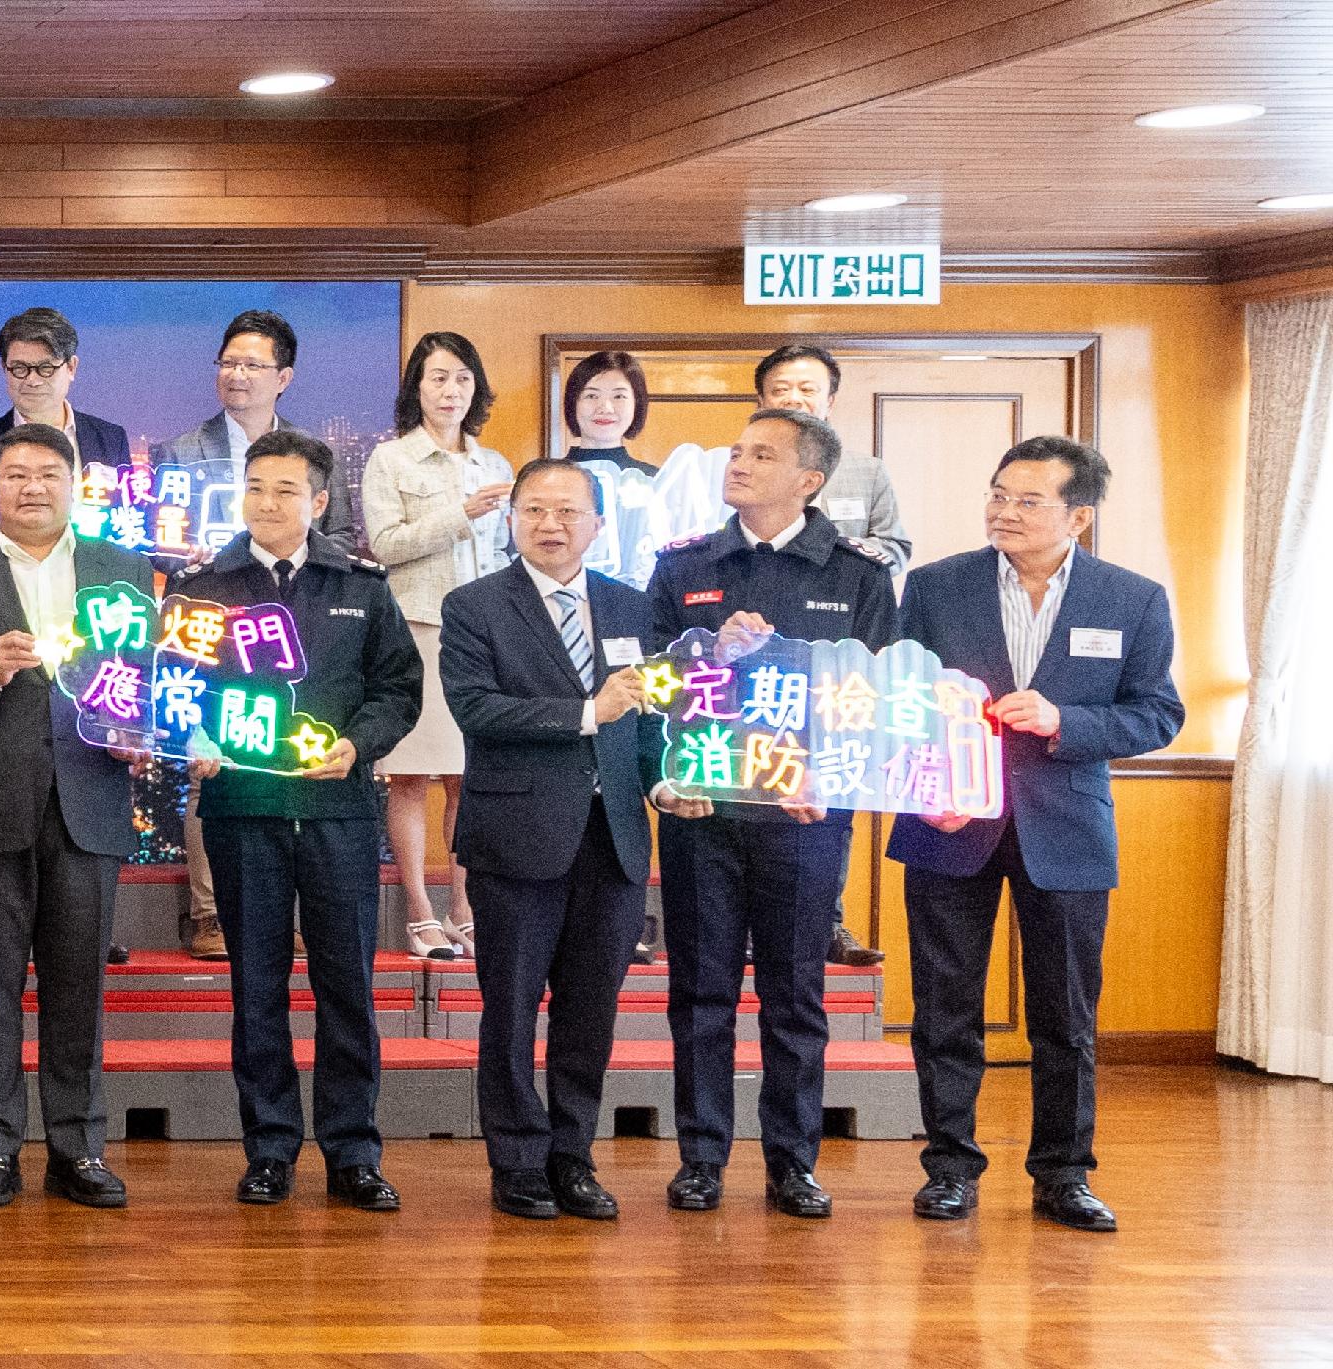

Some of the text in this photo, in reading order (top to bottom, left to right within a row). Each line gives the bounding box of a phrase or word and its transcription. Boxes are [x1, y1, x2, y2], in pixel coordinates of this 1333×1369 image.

[760, 253, 924, 297] EXIT 出口
[87, 591, 295, 673] 防煙門
[82, 656, 276, 755] 應常關
[682, 660, 937, 738] 定期檢查
[682, 722, 950, 806] 消防設備
